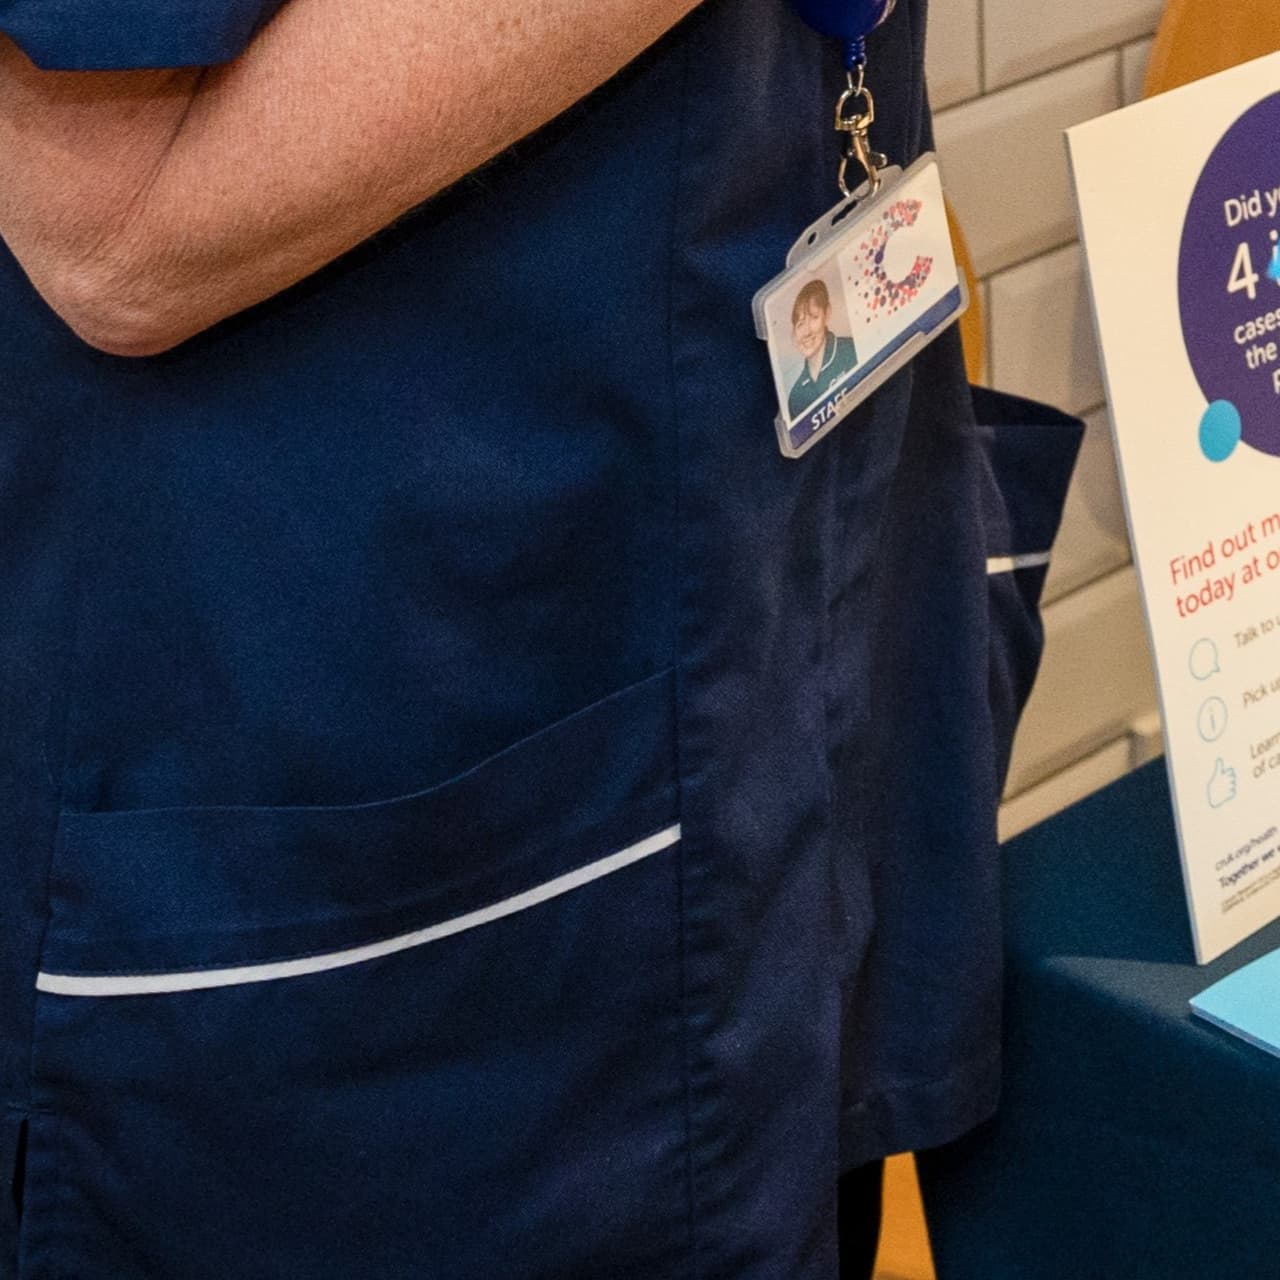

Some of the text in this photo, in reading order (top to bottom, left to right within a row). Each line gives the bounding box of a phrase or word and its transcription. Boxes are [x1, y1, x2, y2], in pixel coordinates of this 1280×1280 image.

[1224, 190, 1262, 227] Did
[1227, 242, 1259, 299] 4
[1246, 341, 1278, 370] the
[1169, 541, 1216, 585] Find
[1220, 523, 1257, 558] out
[1176, 572, 1236, 618] today
[1241, 557, 1262, 584] at
[1233, 627, 1259, 648] Talk
[1260, 618, 1274, 635] to
[1242, 684, 1268, 708] Pick
[1253, 760, 1267, 779] of
